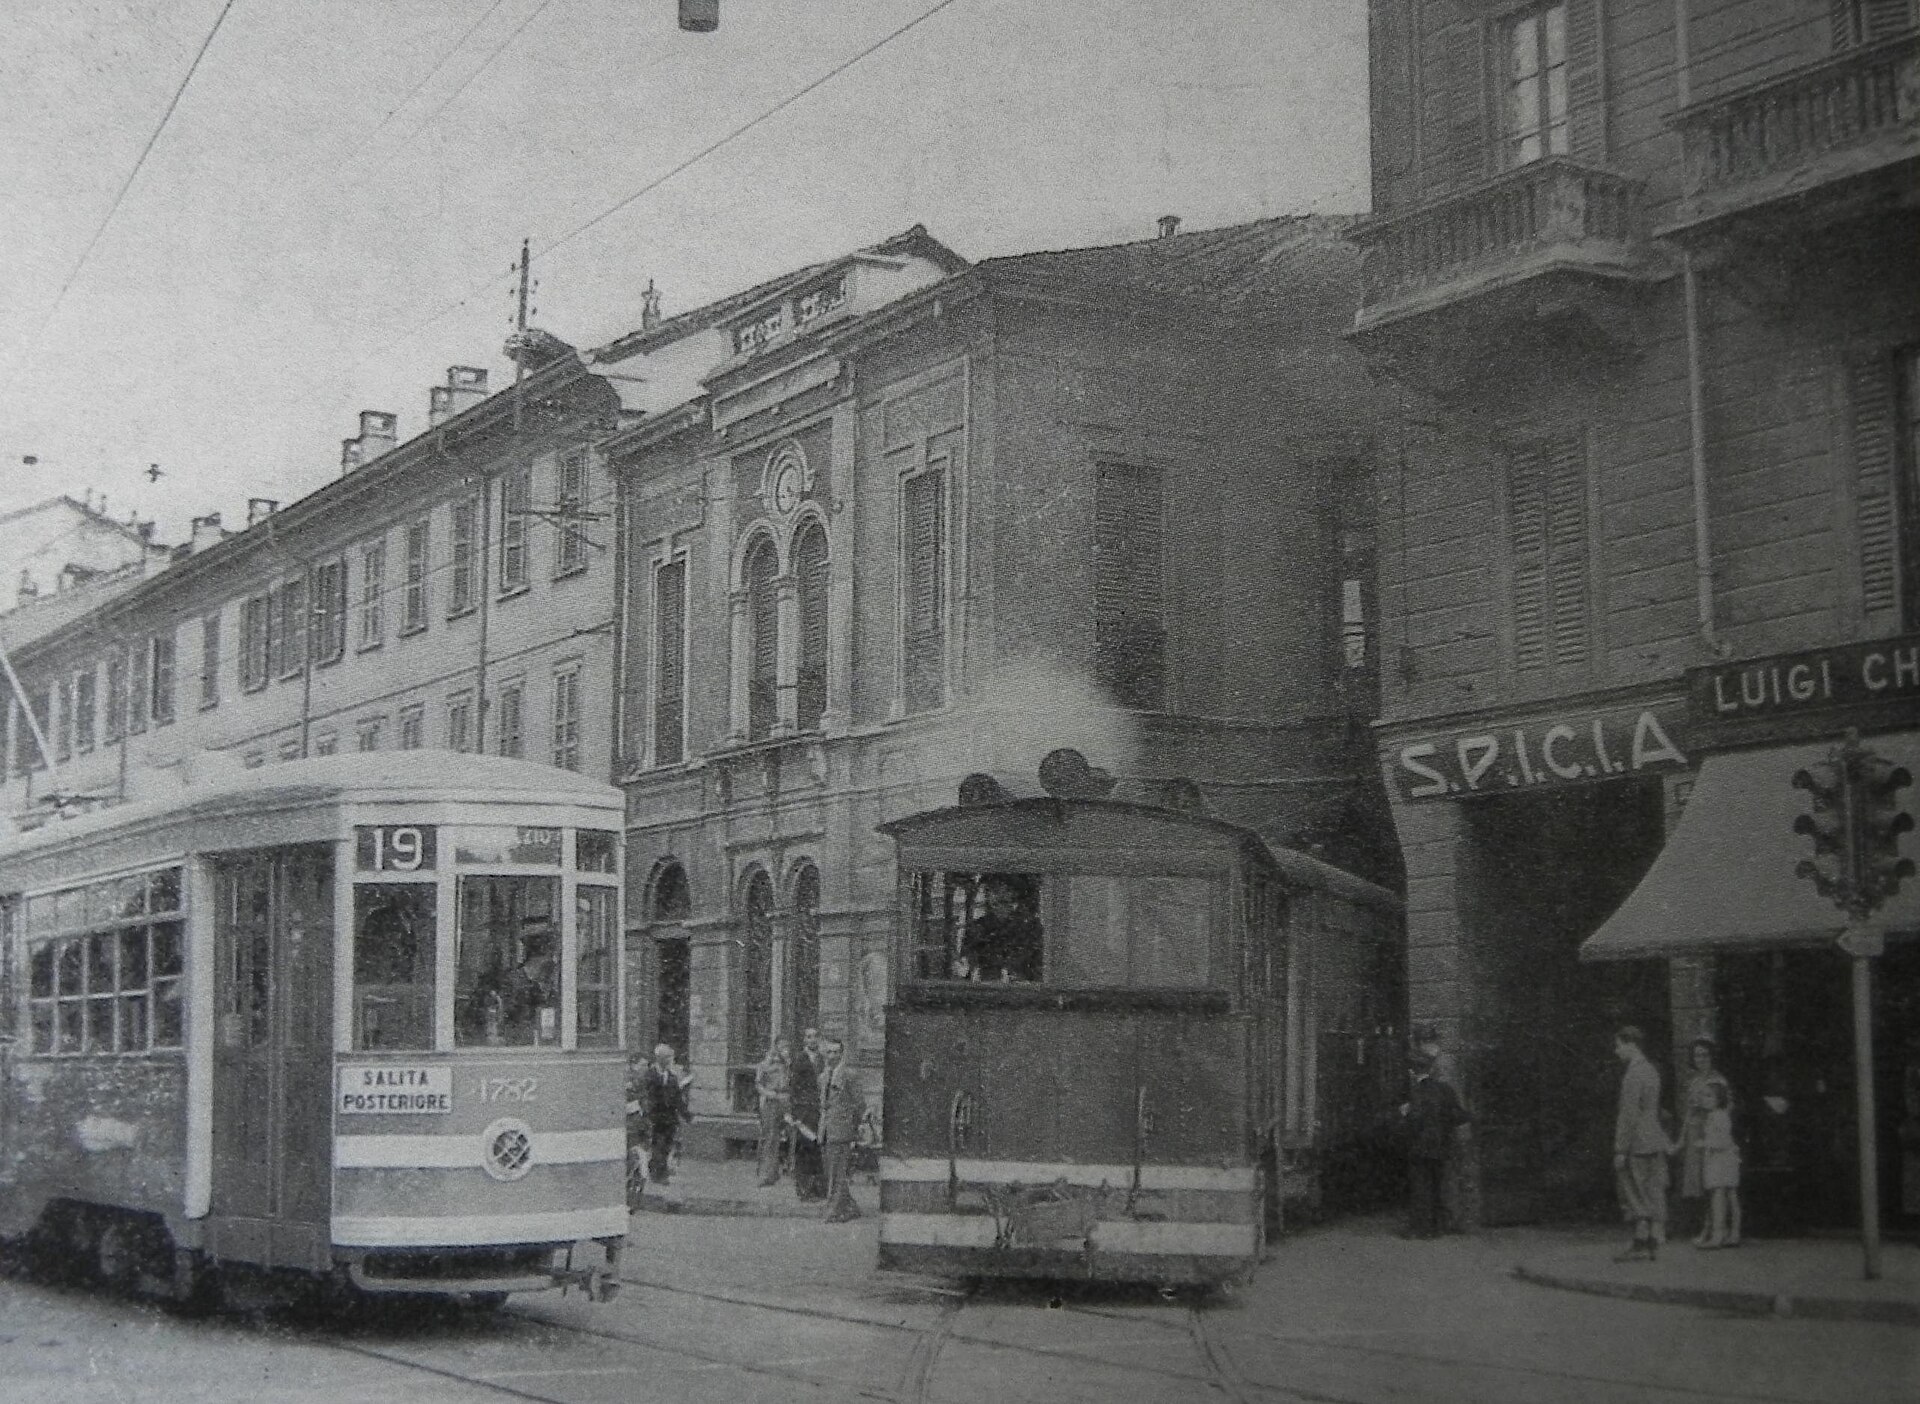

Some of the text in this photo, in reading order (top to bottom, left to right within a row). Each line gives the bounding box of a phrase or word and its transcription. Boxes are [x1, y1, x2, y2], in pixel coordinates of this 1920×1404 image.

[1715, 660, 1831, 712] LUIGI
[373, 827, 423, 871] 19
[363, 1070, 429, 1086] SALITA
[343, 1094, 448, 1110] POSTERIORE
